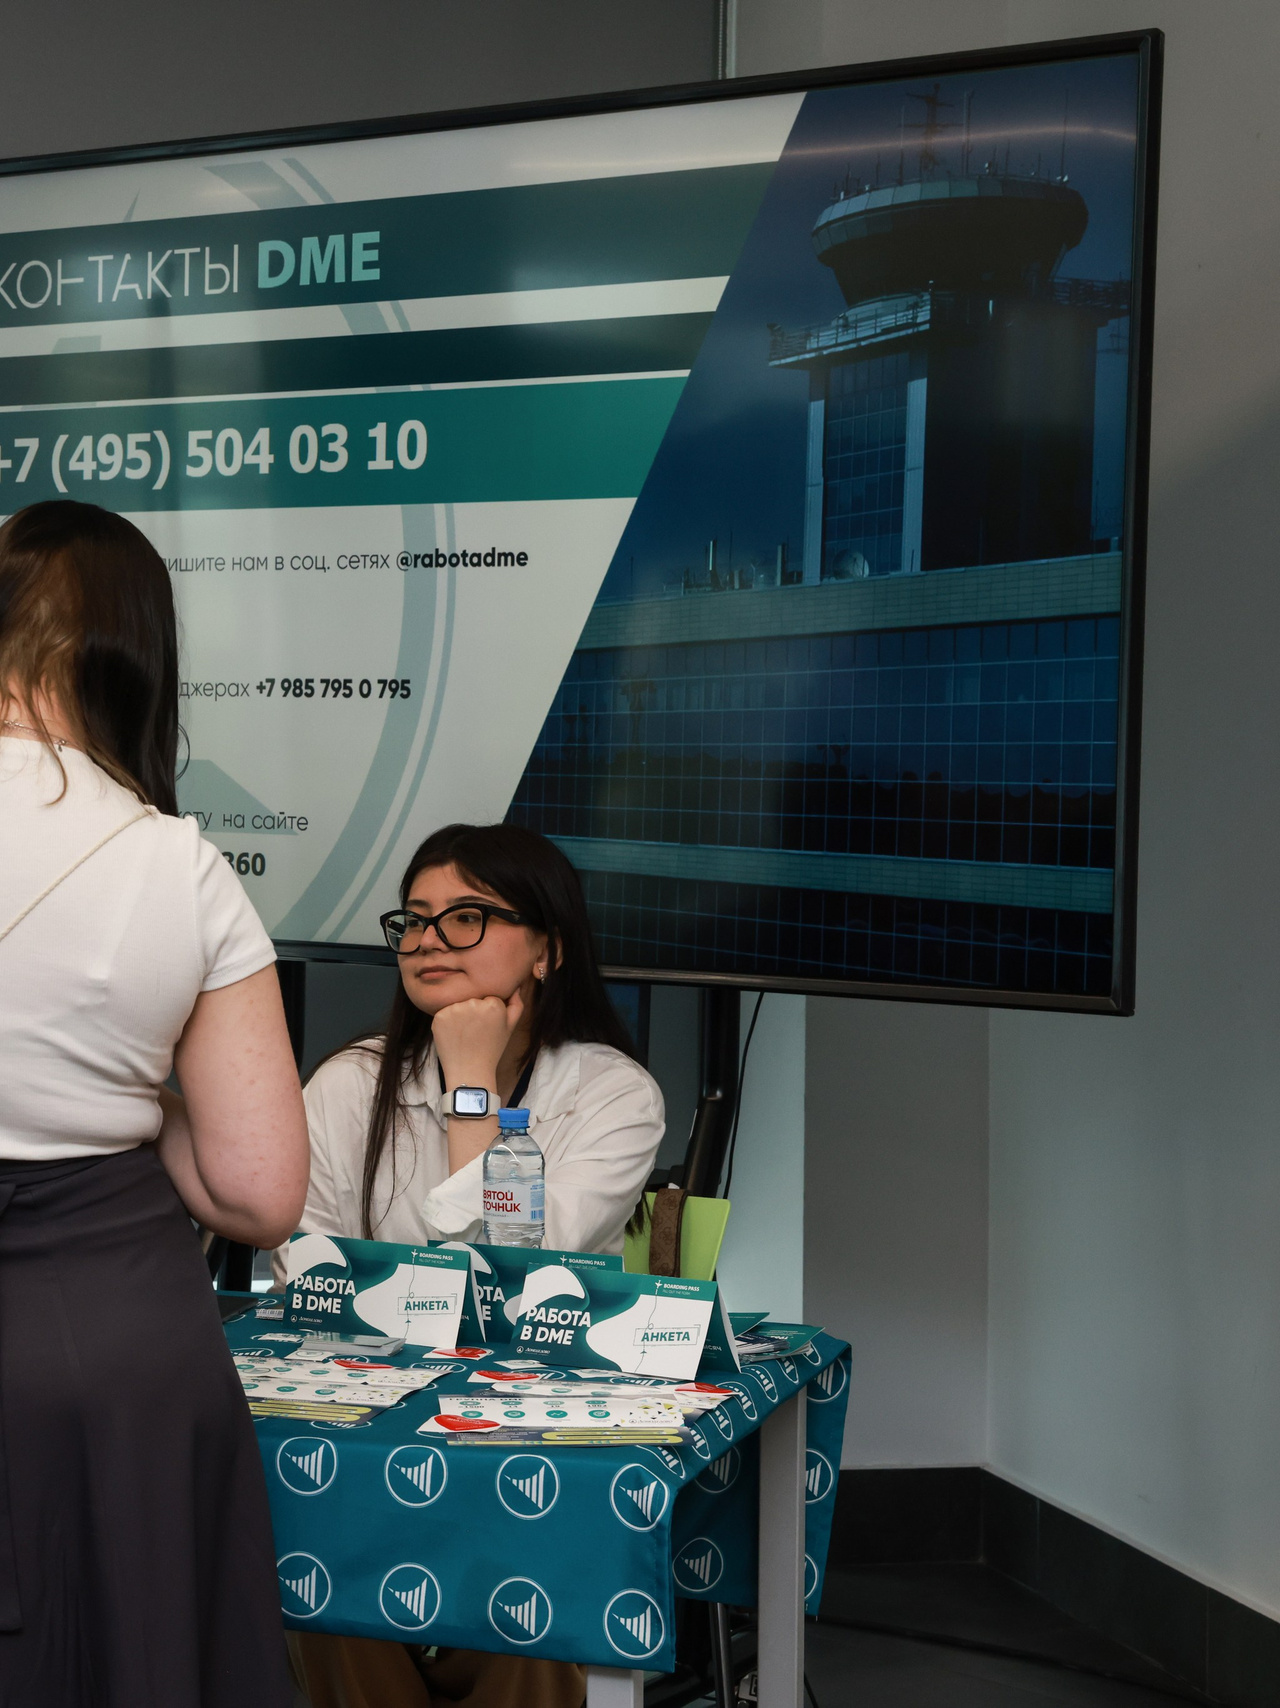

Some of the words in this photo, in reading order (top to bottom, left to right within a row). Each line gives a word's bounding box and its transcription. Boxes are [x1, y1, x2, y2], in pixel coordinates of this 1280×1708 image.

[257, 230, 381, 289] DME
[51, 430, 170, 493] (495)
[185, 428, 274, 478] 504
[288, 423, 349, 474] 03
[367, 419, 428, 471] 10
[231, 554, 269, 571] нам
[274, 555, 285, 571] в
[289, 552, 332, 573] соц.
[336, 551, 391, 571] сетях
[395, 547, 530, 571] @rabotadme
[179, 681, 251, 702] джерах
[255, 677, 276, 698] +7
[280, 678, 315, 698] 985
[320, 678, 353, 699] 795
[358, 679, 373, 699] 0
[377, 679, 412, 699] 795
[222, 812, 246, 829] на
[251, 811, 309, 832] сайте
[483, 1189, 514, 1201] ВЯТОЙ
[483, 1200, 522, 1213] ТОЧНИК
[293, 1275, 357, 1297] РАБОТА
[306, 1294, 342, 1315] DME
[404, 1300, 449, 1311] АНКЕТА
[524, 1306, 592, 1328] РАБОТА
[535, 1327, 574, 1345] DME
[640, 1330, 691, 1342] АНКЕТА
